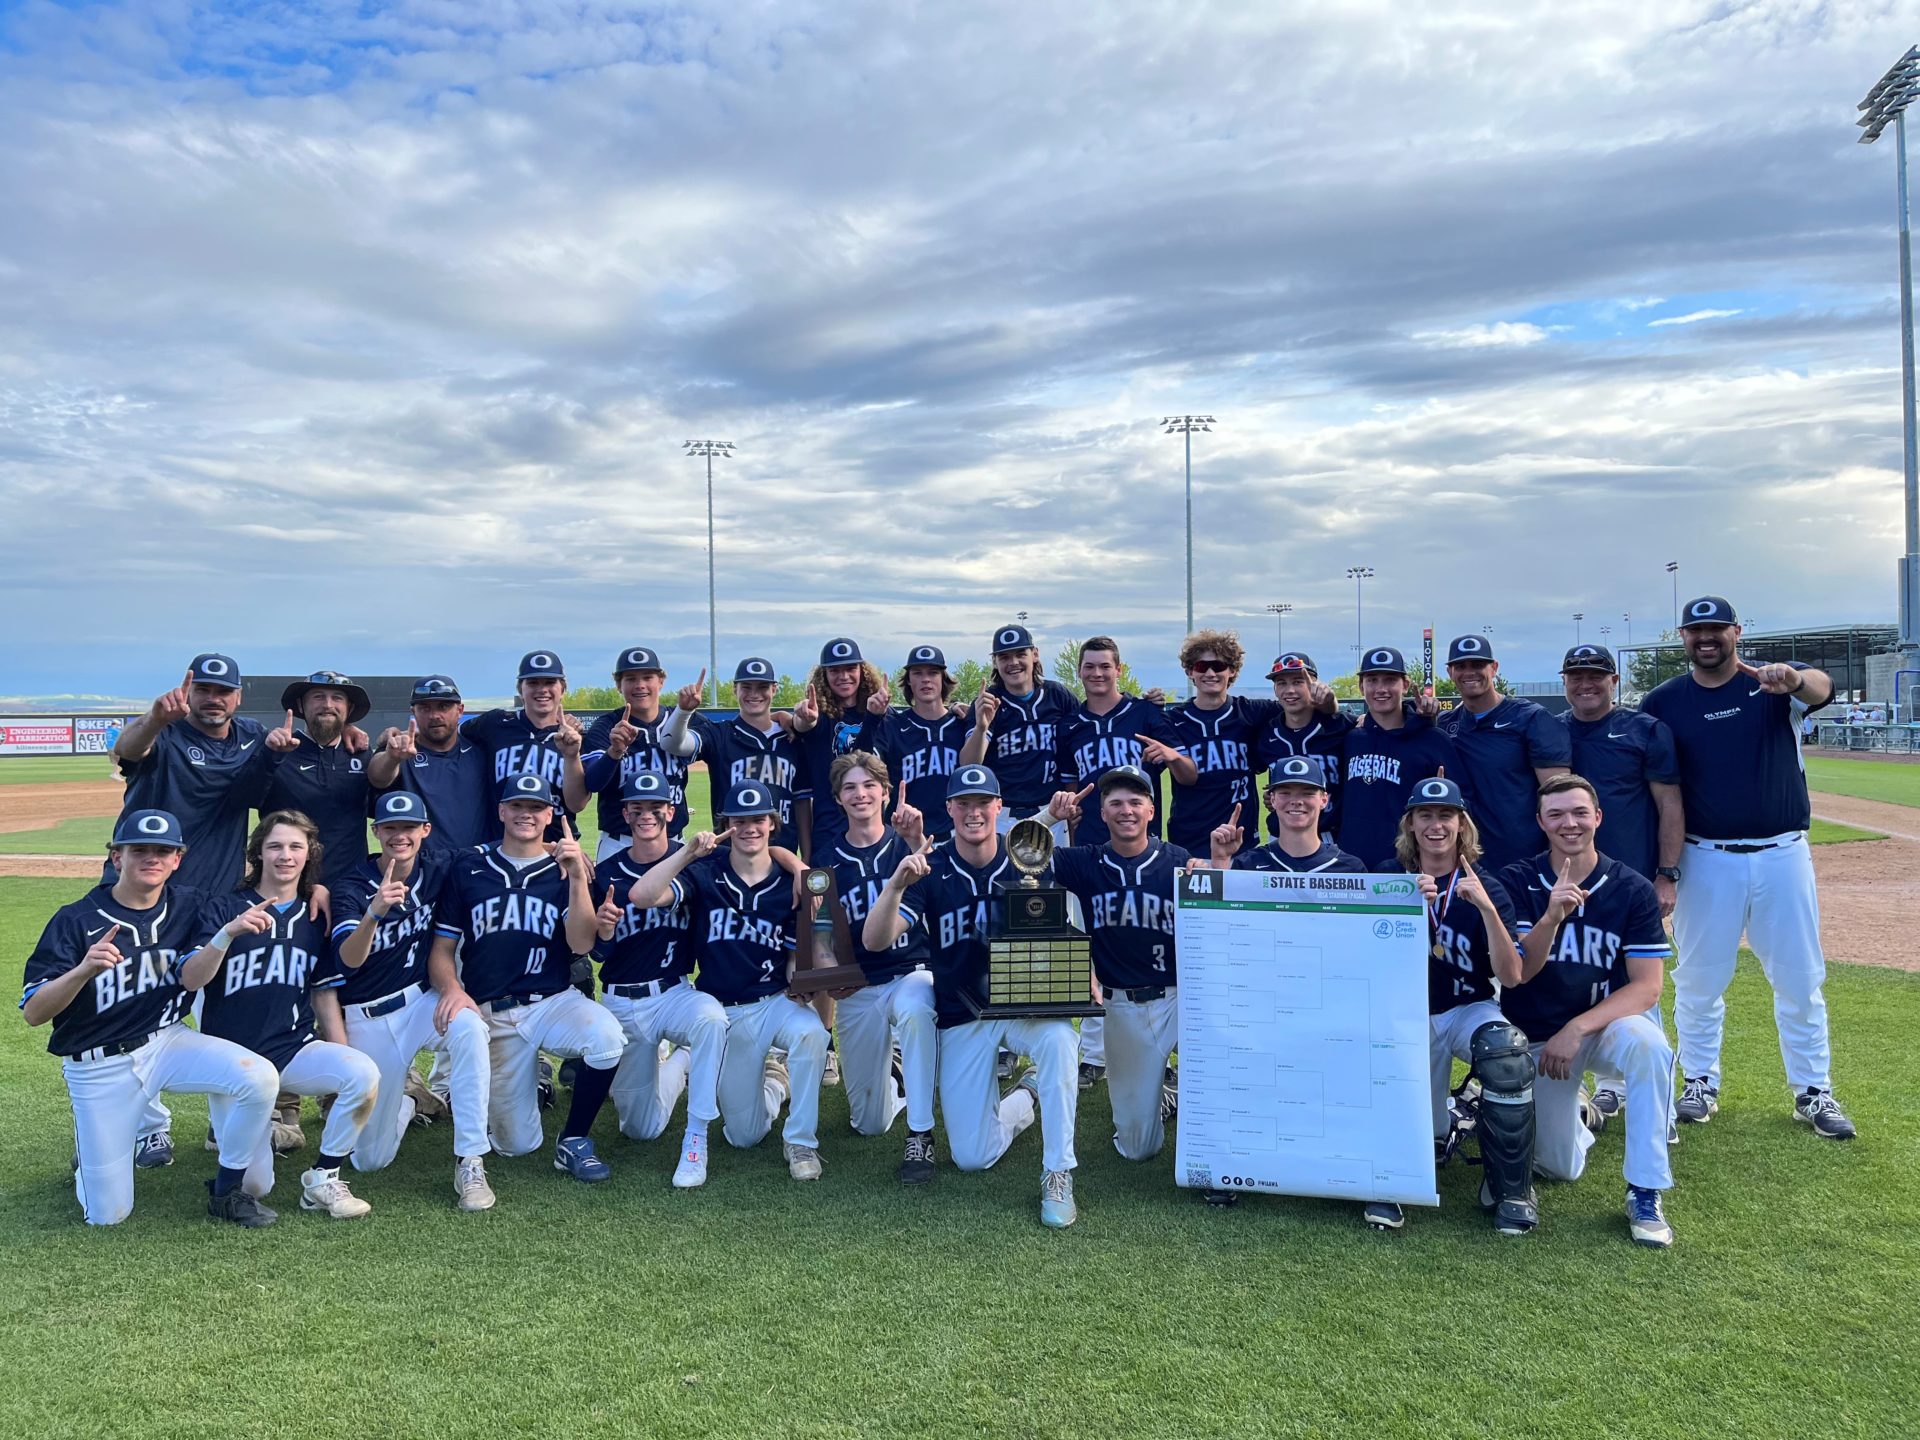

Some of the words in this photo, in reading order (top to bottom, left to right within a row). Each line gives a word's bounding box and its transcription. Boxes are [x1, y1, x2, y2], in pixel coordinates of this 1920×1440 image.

[1691, 601, 1717, 617] O
[1000, 630, 1020, 645] O
[1458, 638, 1480, 652] O
[628, 651, 649, 664] O
[832, 643, 852, 657] O
[916, 648, 935, 660] O
[1371, 651, 1393, 665] O
[201, 659, 228, 675] O
[530, 655, 552, 668] O
[747, 662, 767, 674] O
[1424, 640, 1432, 685] TOYOTA
[1704, 707, 1741, 718] OLYMPIA
[88, 720, 112, 729] KEP
[902, 747, 957, 784] BEAR
[1074, 737, 1143, 783] BEARS
[1189, 739, 1249, 774] EARS
[619, 748, 686, 788] BEAR
[1284, 760, 1309, 775] O
[1347, 757, 1401, 785] BASEBALL
[517, 776, 542, 791] O
[635, 775, 659, 790] O
[961, 769, 986, 785] O
[738, 789, 761, 806] O
[1231, 776, 1248, 803] 23
[1422, 781, 1449, 798] O
[386, 796, 413, 812] O
[138, 816, 169, 834] O
[1188, 875, 1212, 894] 4A
[1270, 876, 1305, 889] STATE
[1309, 878, 1366, 890] BASEBALL
[1378, 883, 1409, 893] WIAA
[840, 878, 890, 926] BEA
[471, 894, 559, 943] BEARS
[1091, 890, 1174, 935] BEARS
[369, 904, 436, 954] BEAR
[707, 907, 784, 951] BEARS
[939, 900, 988, 950] BEA
[661, 941, 678, 968] 5
[1548, 922, 1622, 971] ARS
[525, 946, 546, 975] 10
[1152, 944, 1166, 972] 3
[224, 944, 318, 997] BEAR
[760, 959, 774, 983] 2
[95, 948, 180, 1016] BEAR
